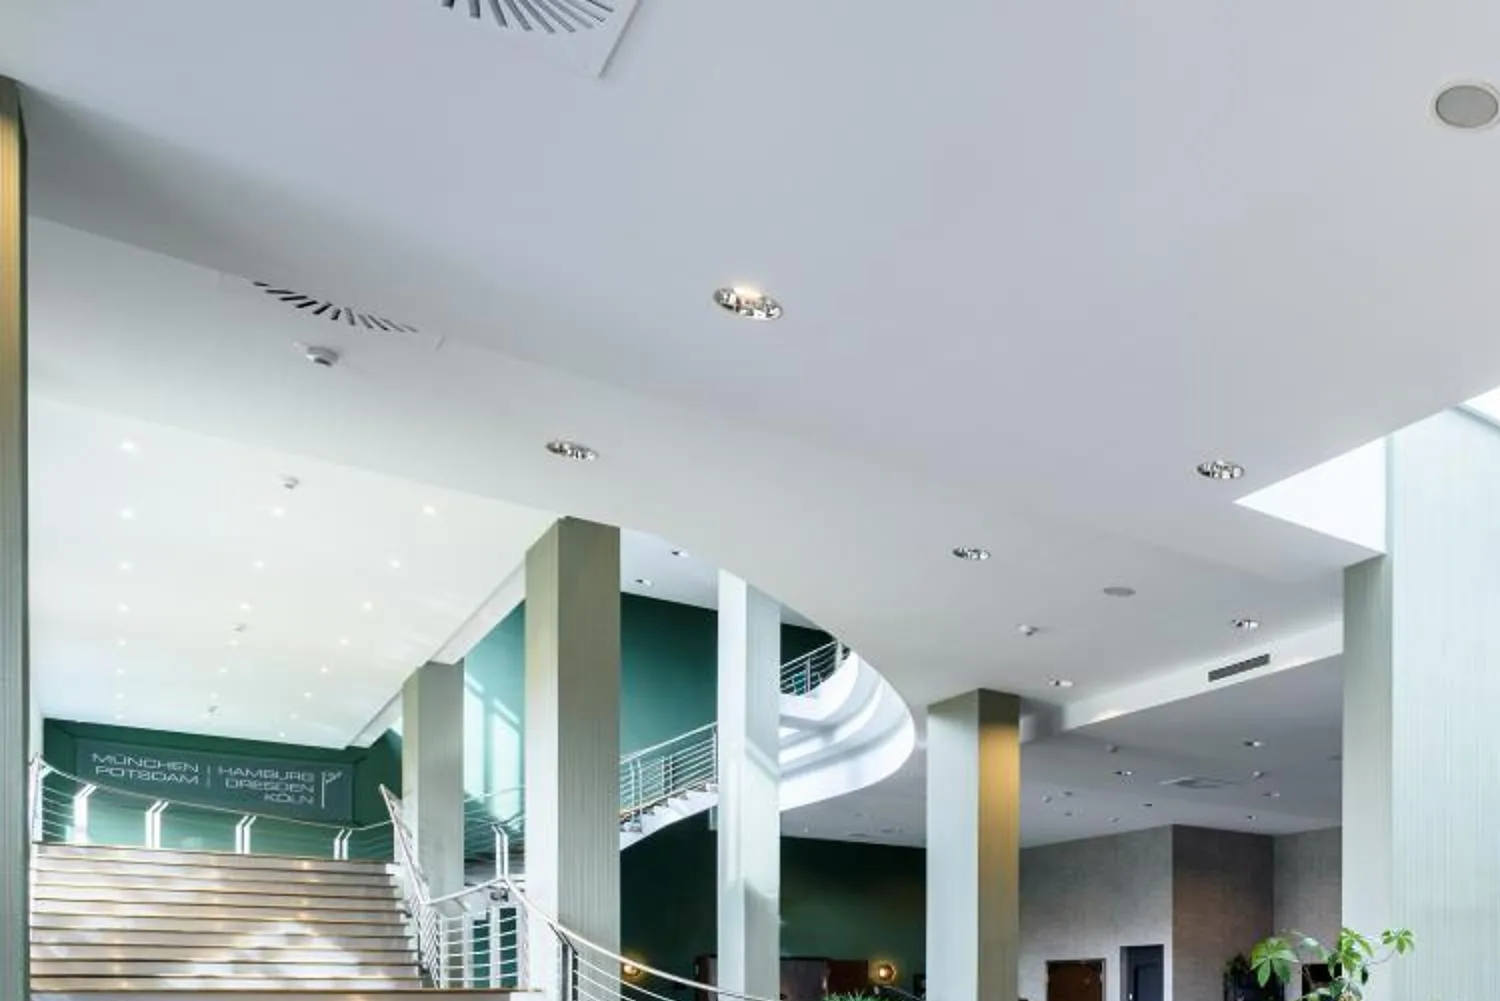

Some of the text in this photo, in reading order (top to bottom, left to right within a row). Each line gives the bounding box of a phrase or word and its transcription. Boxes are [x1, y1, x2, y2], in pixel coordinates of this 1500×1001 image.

[95, 765, 199, 784] POTSDAM
[218, 765, 314, 782] HAMBURG
[225, 777, 315, 794] DRESDEN
[263, 790, 315, 805] KÖLN
